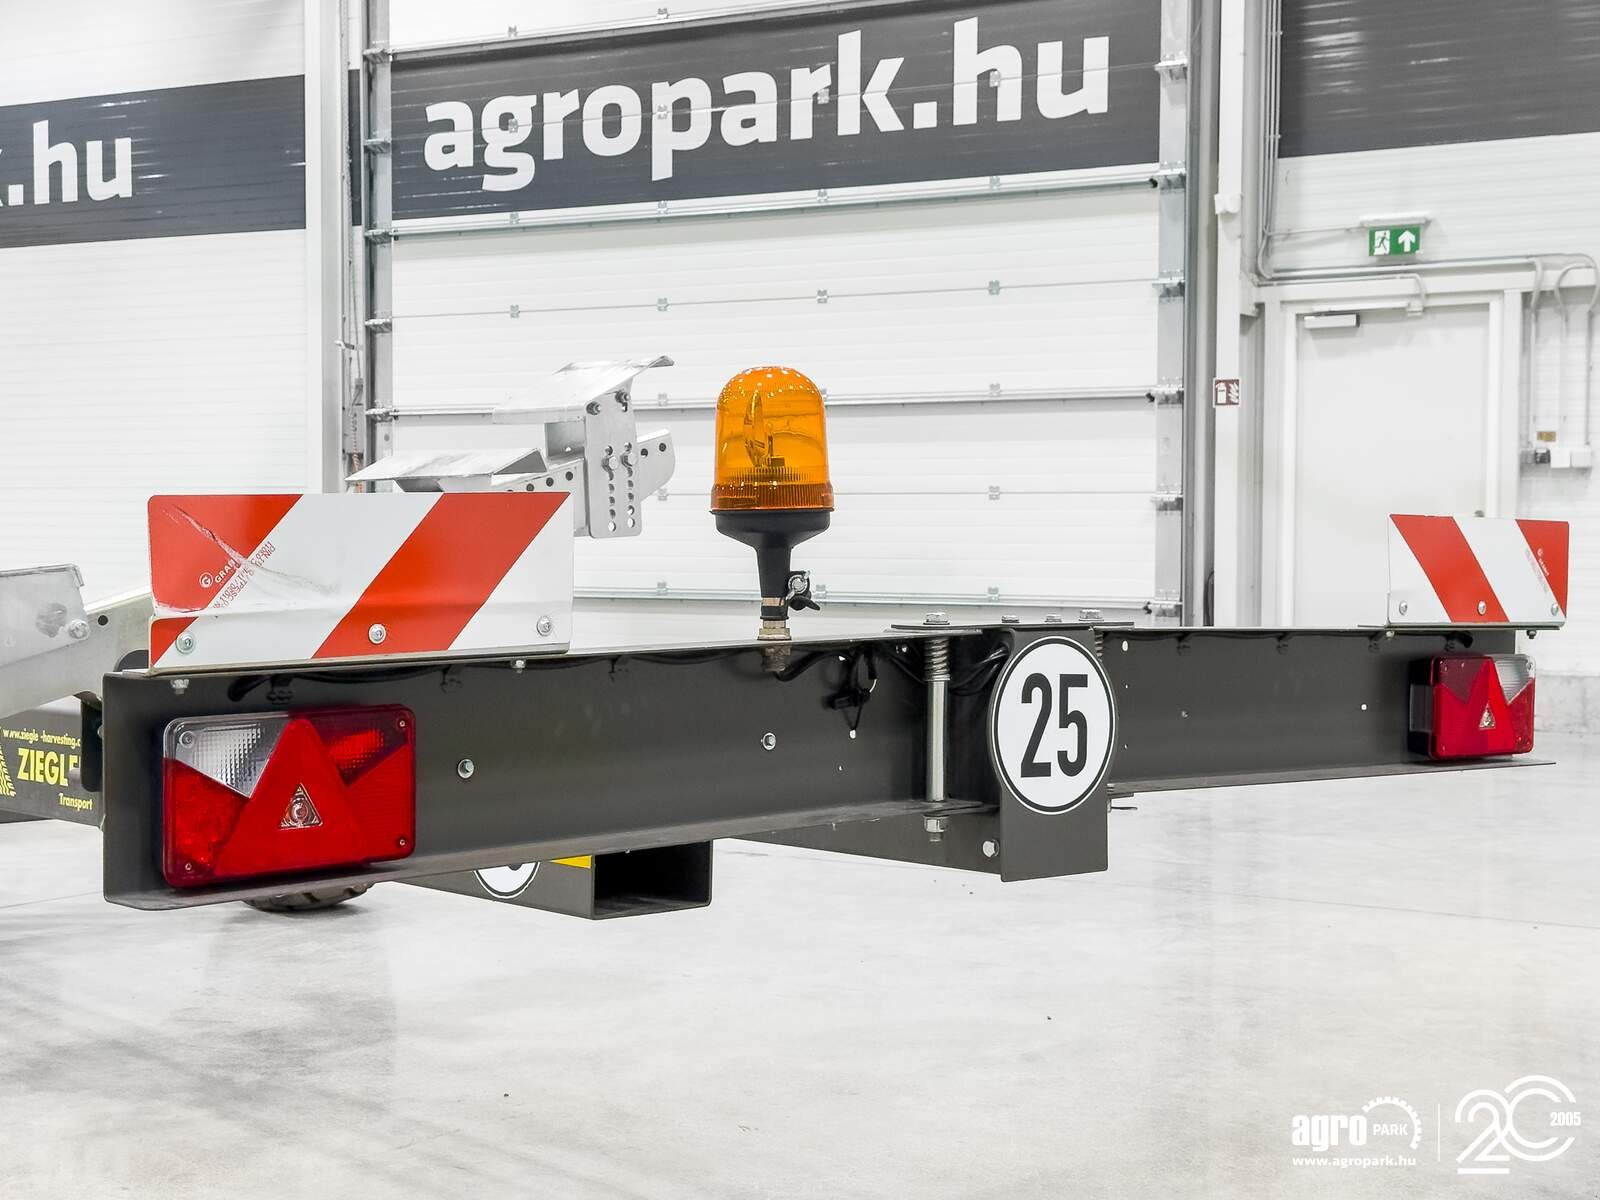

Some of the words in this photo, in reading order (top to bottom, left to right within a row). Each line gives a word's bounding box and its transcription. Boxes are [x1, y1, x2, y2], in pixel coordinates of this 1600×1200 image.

[424, 17, 1110, 192] agropark.hu
[0, 119, 133, 207] .hu
[17, 747, 81, 787] ZIEGL
[1020, 672, 1088, 778] 25
[58, 792, 93, 812] Transport
